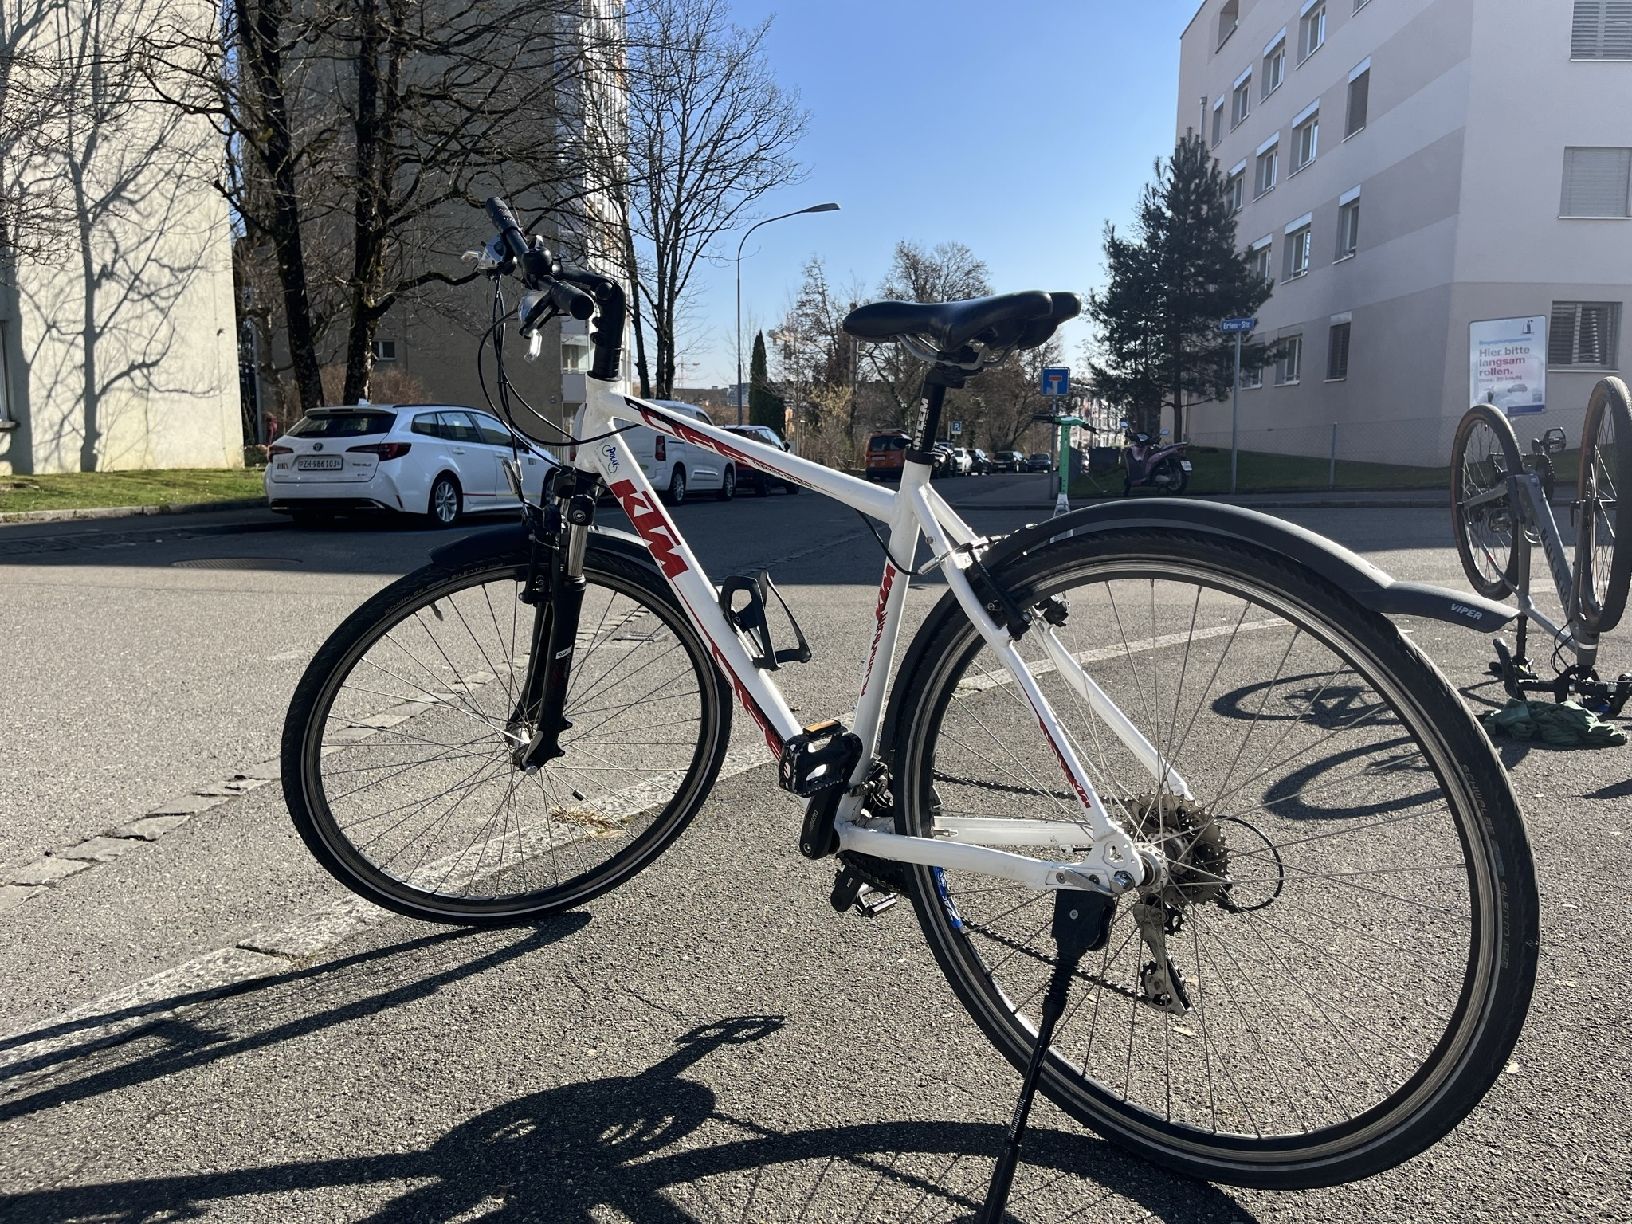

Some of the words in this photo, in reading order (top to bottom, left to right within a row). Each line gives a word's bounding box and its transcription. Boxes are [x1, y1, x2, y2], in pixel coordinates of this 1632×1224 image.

[1480, 348, 1502, 357] Hier
[1504, 346, 1531, 356] bitte
[1479, 357, 1525, 368] langsam
[1479, 367, 1513, 376] rollen.
[609, 479, 689, 579] KTM
[1450, 603, 1483, 620] VIPER
